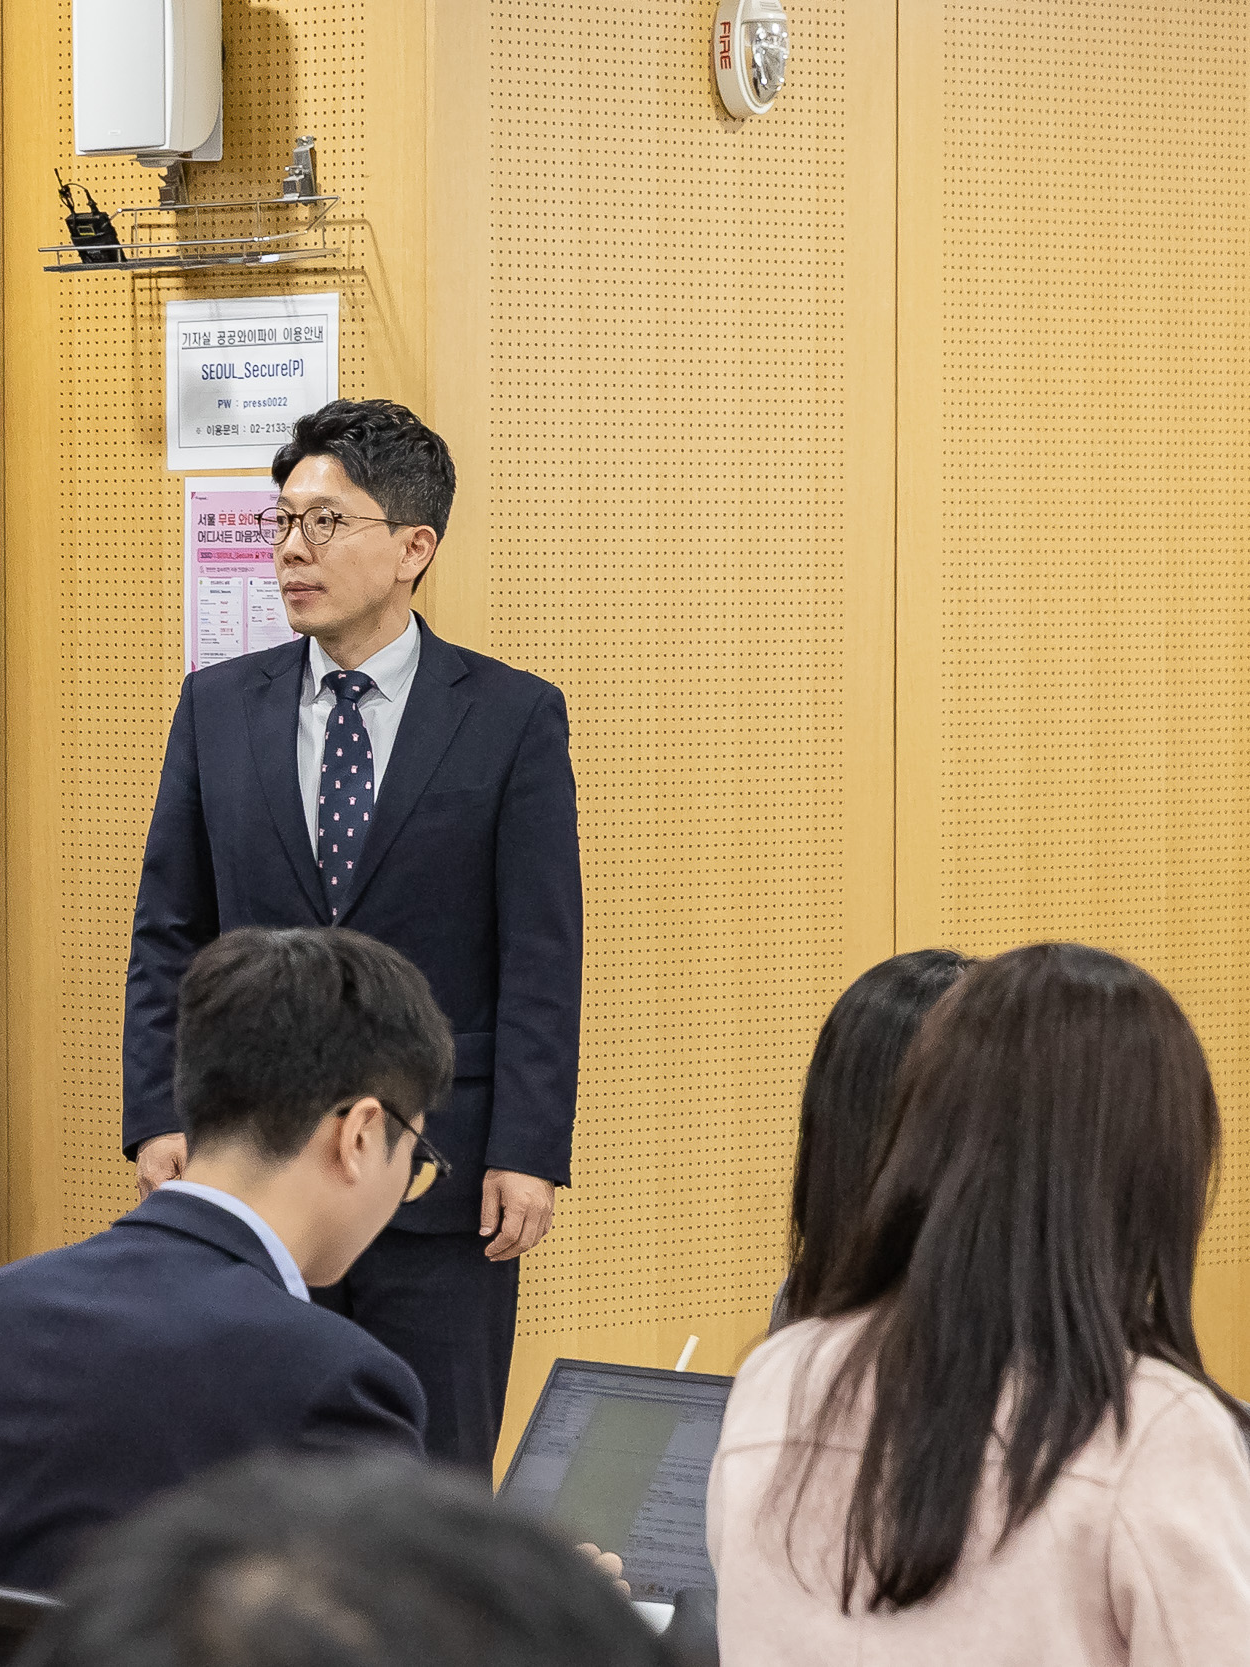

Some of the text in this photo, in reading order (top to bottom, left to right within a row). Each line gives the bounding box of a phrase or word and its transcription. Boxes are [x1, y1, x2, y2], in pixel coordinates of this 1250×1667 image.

[720, 21, 732, 70] FIRE
[182, 325, 324, 346] 기자실 공공와이파이 이용안내
[217, 399, 232, 409] PW
[243, 397, 288, 408] press0022
[206, 423, 239, 436] 이용문의
[198, 514, 216, 526] 서울
[218, 514, 236, 526] 무료
[198, 530, 232, 543] 어디서든
